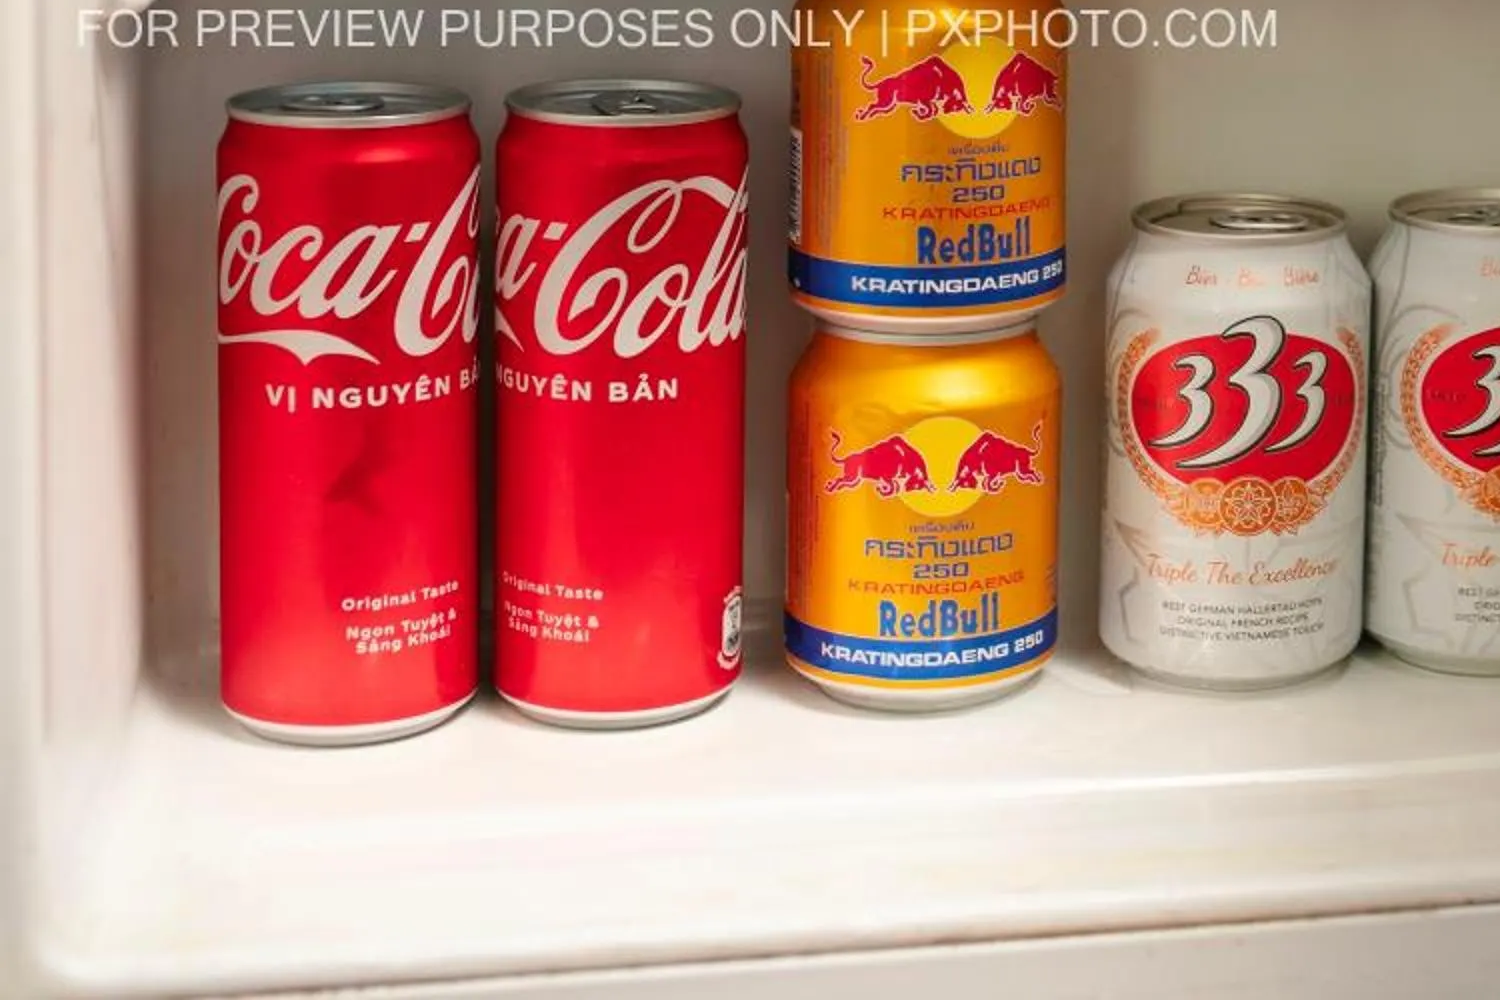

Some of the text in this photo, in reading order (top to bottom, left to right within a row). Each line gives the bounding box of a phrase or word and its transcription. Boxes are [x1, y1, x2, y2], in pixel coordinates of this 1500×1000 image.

[951, 185, 1005, 203] 250
[916, 216, 1031, 265] RedBull
[851, 259, 1063, 294] KRATINGDAENG 250
[265, 383, 296, 413] VỊ
[311, 373, 451, 411] NGUYÊN
[608, 371, 679, 401] BẢN
[1147, 314, 1327, 469] 333
[848, 571, 1025, 595] KRATINGDAENG
[912, 562, 970, 580] 250
[1146, 553, 1197, 585] Triple
[1206, 561, 1244, 585] The
[341, 580, 459, 612] Original Taste
[555, 584, 604, 601] Taste
[879, 592, 1001, 638] RedBull
[346, 624, 396, 642] Ngon
[820, 629, 1044, 668] KRATINGDAENG 250
